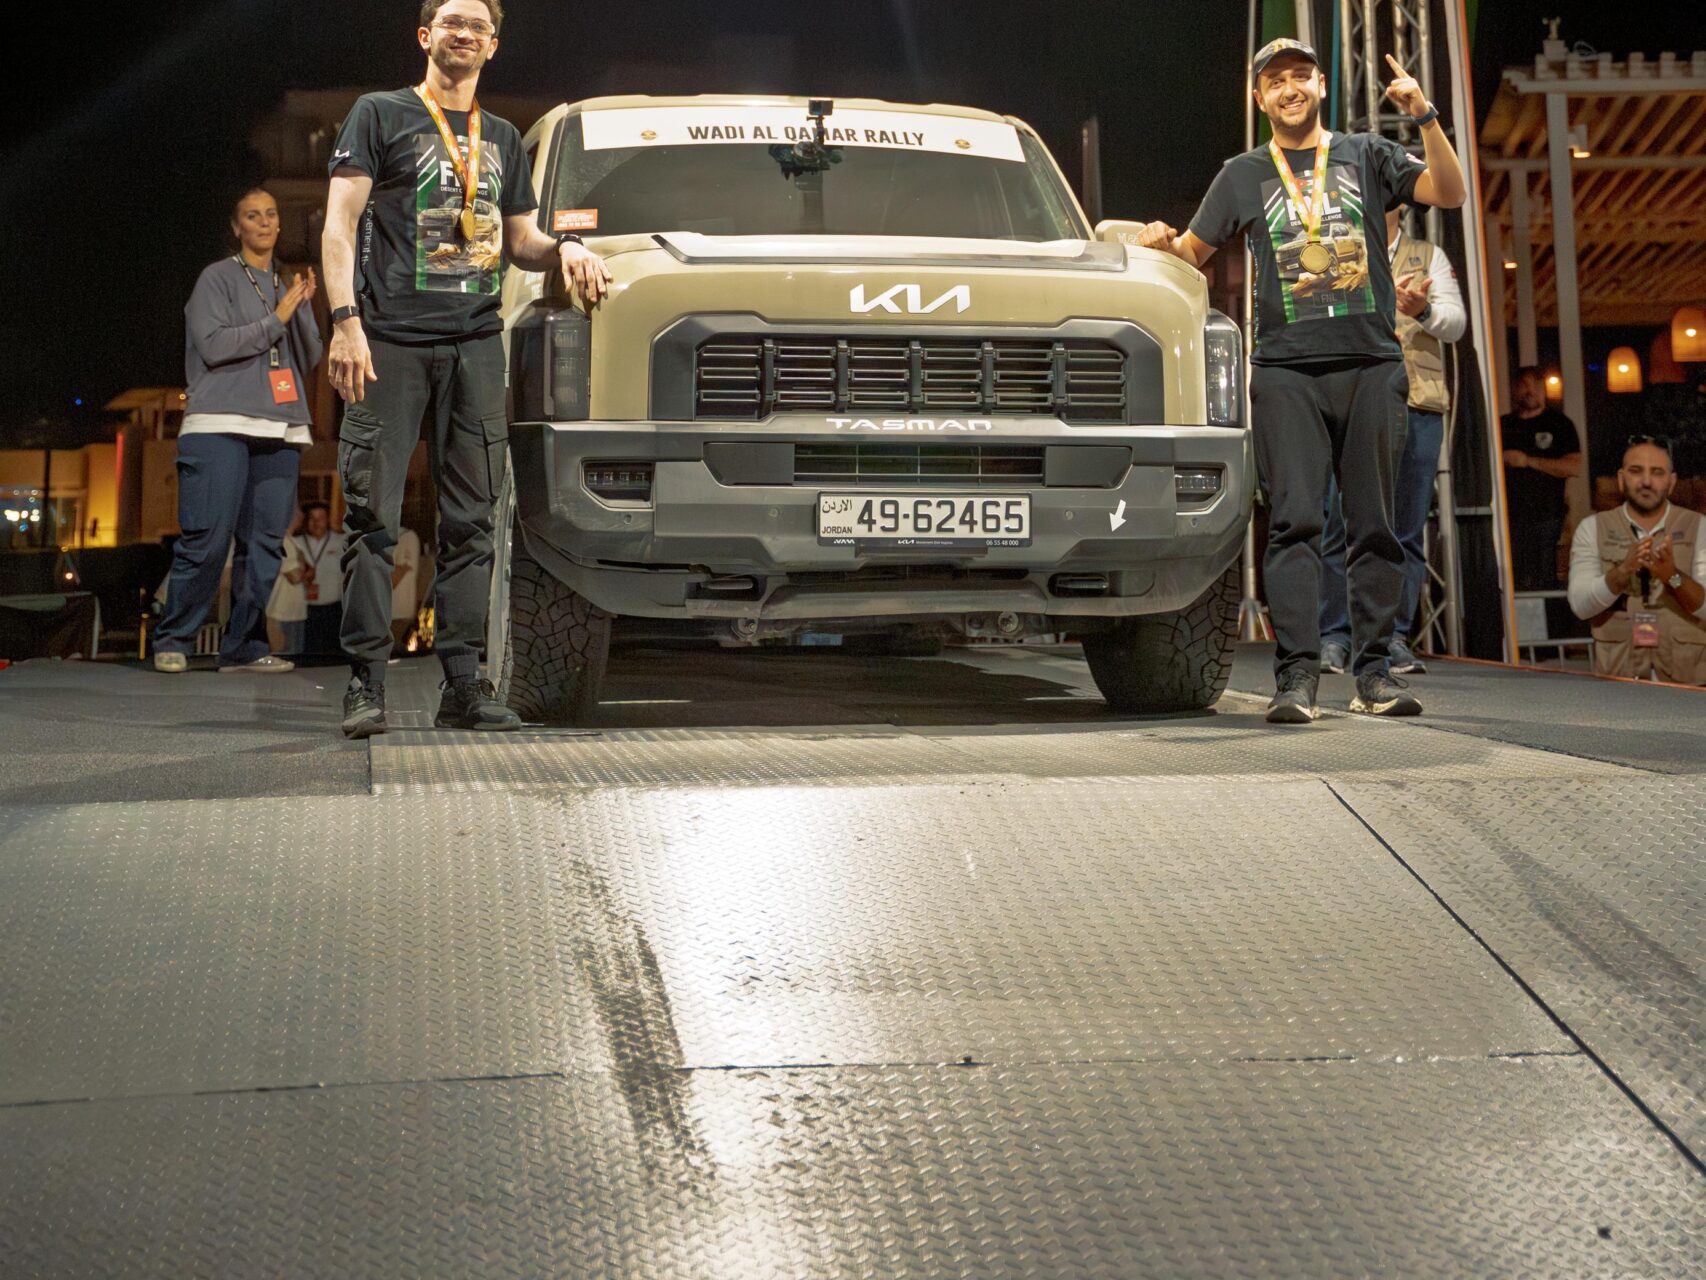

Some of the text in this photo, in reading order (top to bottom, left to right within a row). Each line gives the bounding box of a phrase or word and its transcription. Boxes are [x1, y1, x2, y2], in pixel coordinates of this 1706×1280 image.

[687, 125, 745, 140] WADI
[752, 126, 778, 140] AL
[864, 129, 924, 146] RALLY
[850, 283, 971, 314] KIA
[826, 417, 992, 431] TASMAN
[856, 499, 1023, 533] 49-62465
[822, 526, 853, 534] JORDAN
